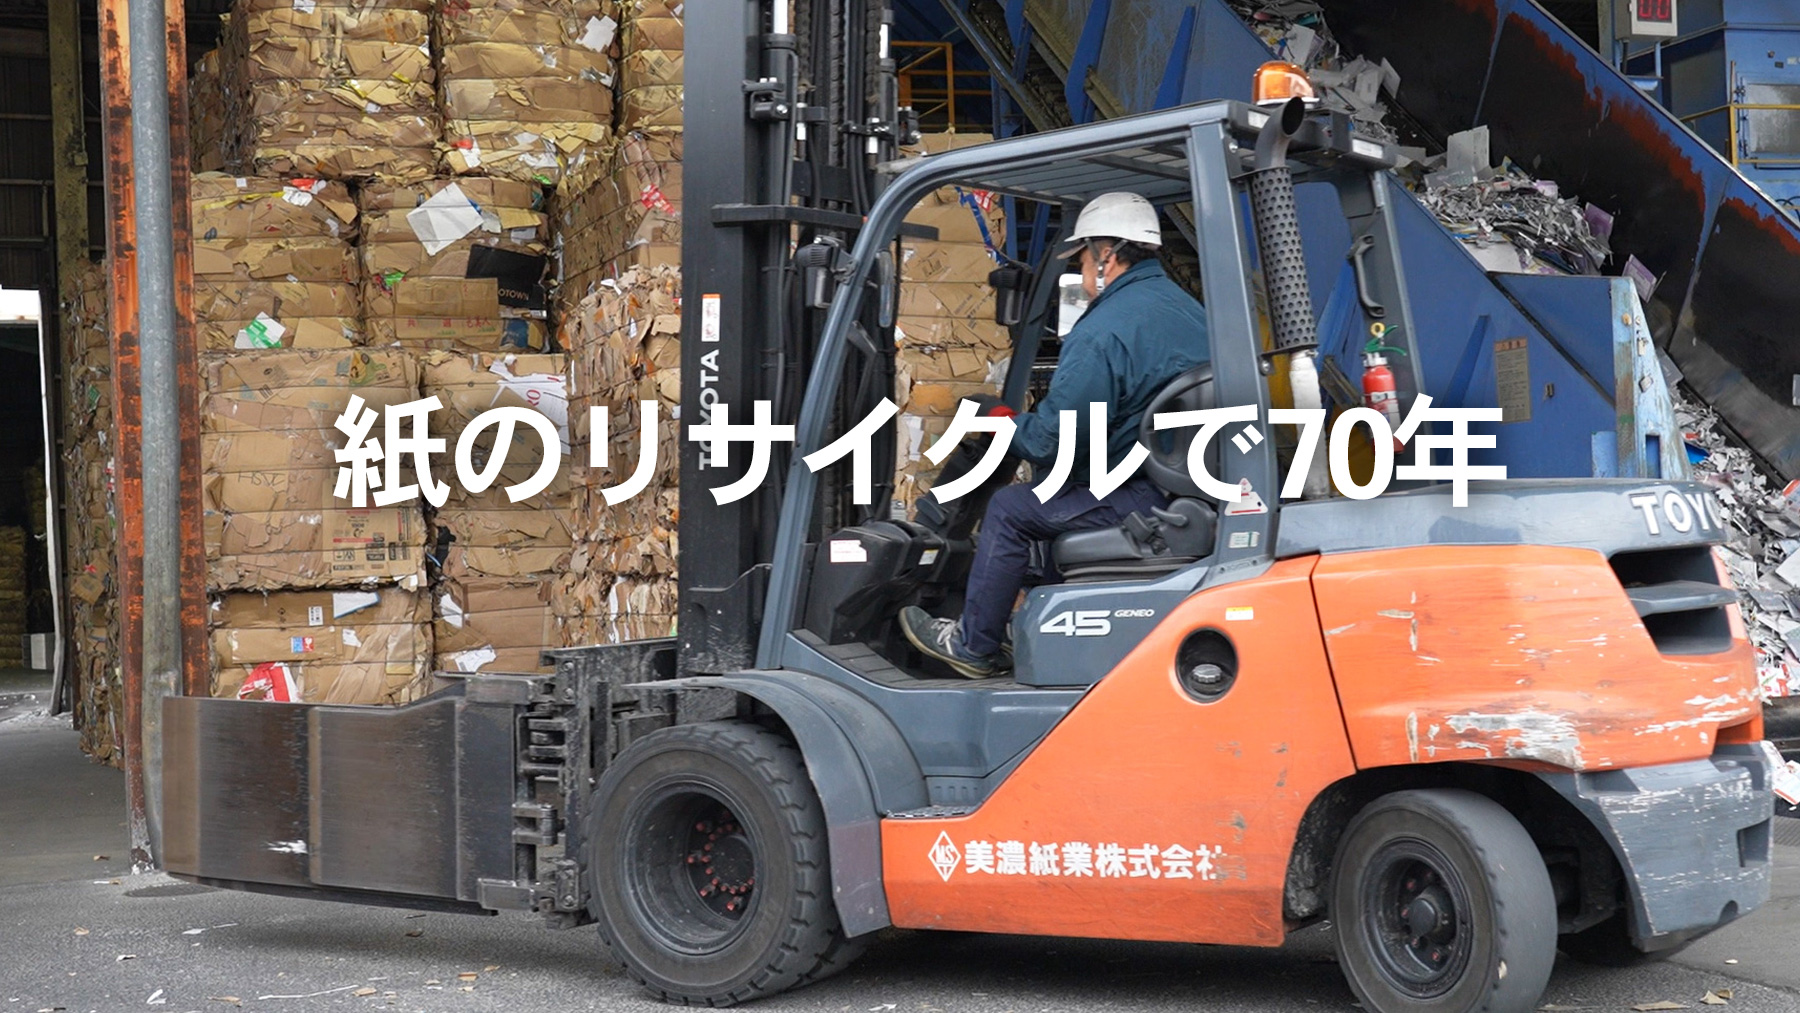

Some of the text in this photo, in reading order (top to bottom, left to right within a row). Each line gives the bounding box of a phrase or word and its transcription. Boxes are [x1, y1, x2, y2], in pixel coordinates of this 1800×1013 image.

[699, 349, 720, 471] TYOTA
[1039, 608, 1156, 636] 45 GENEO
